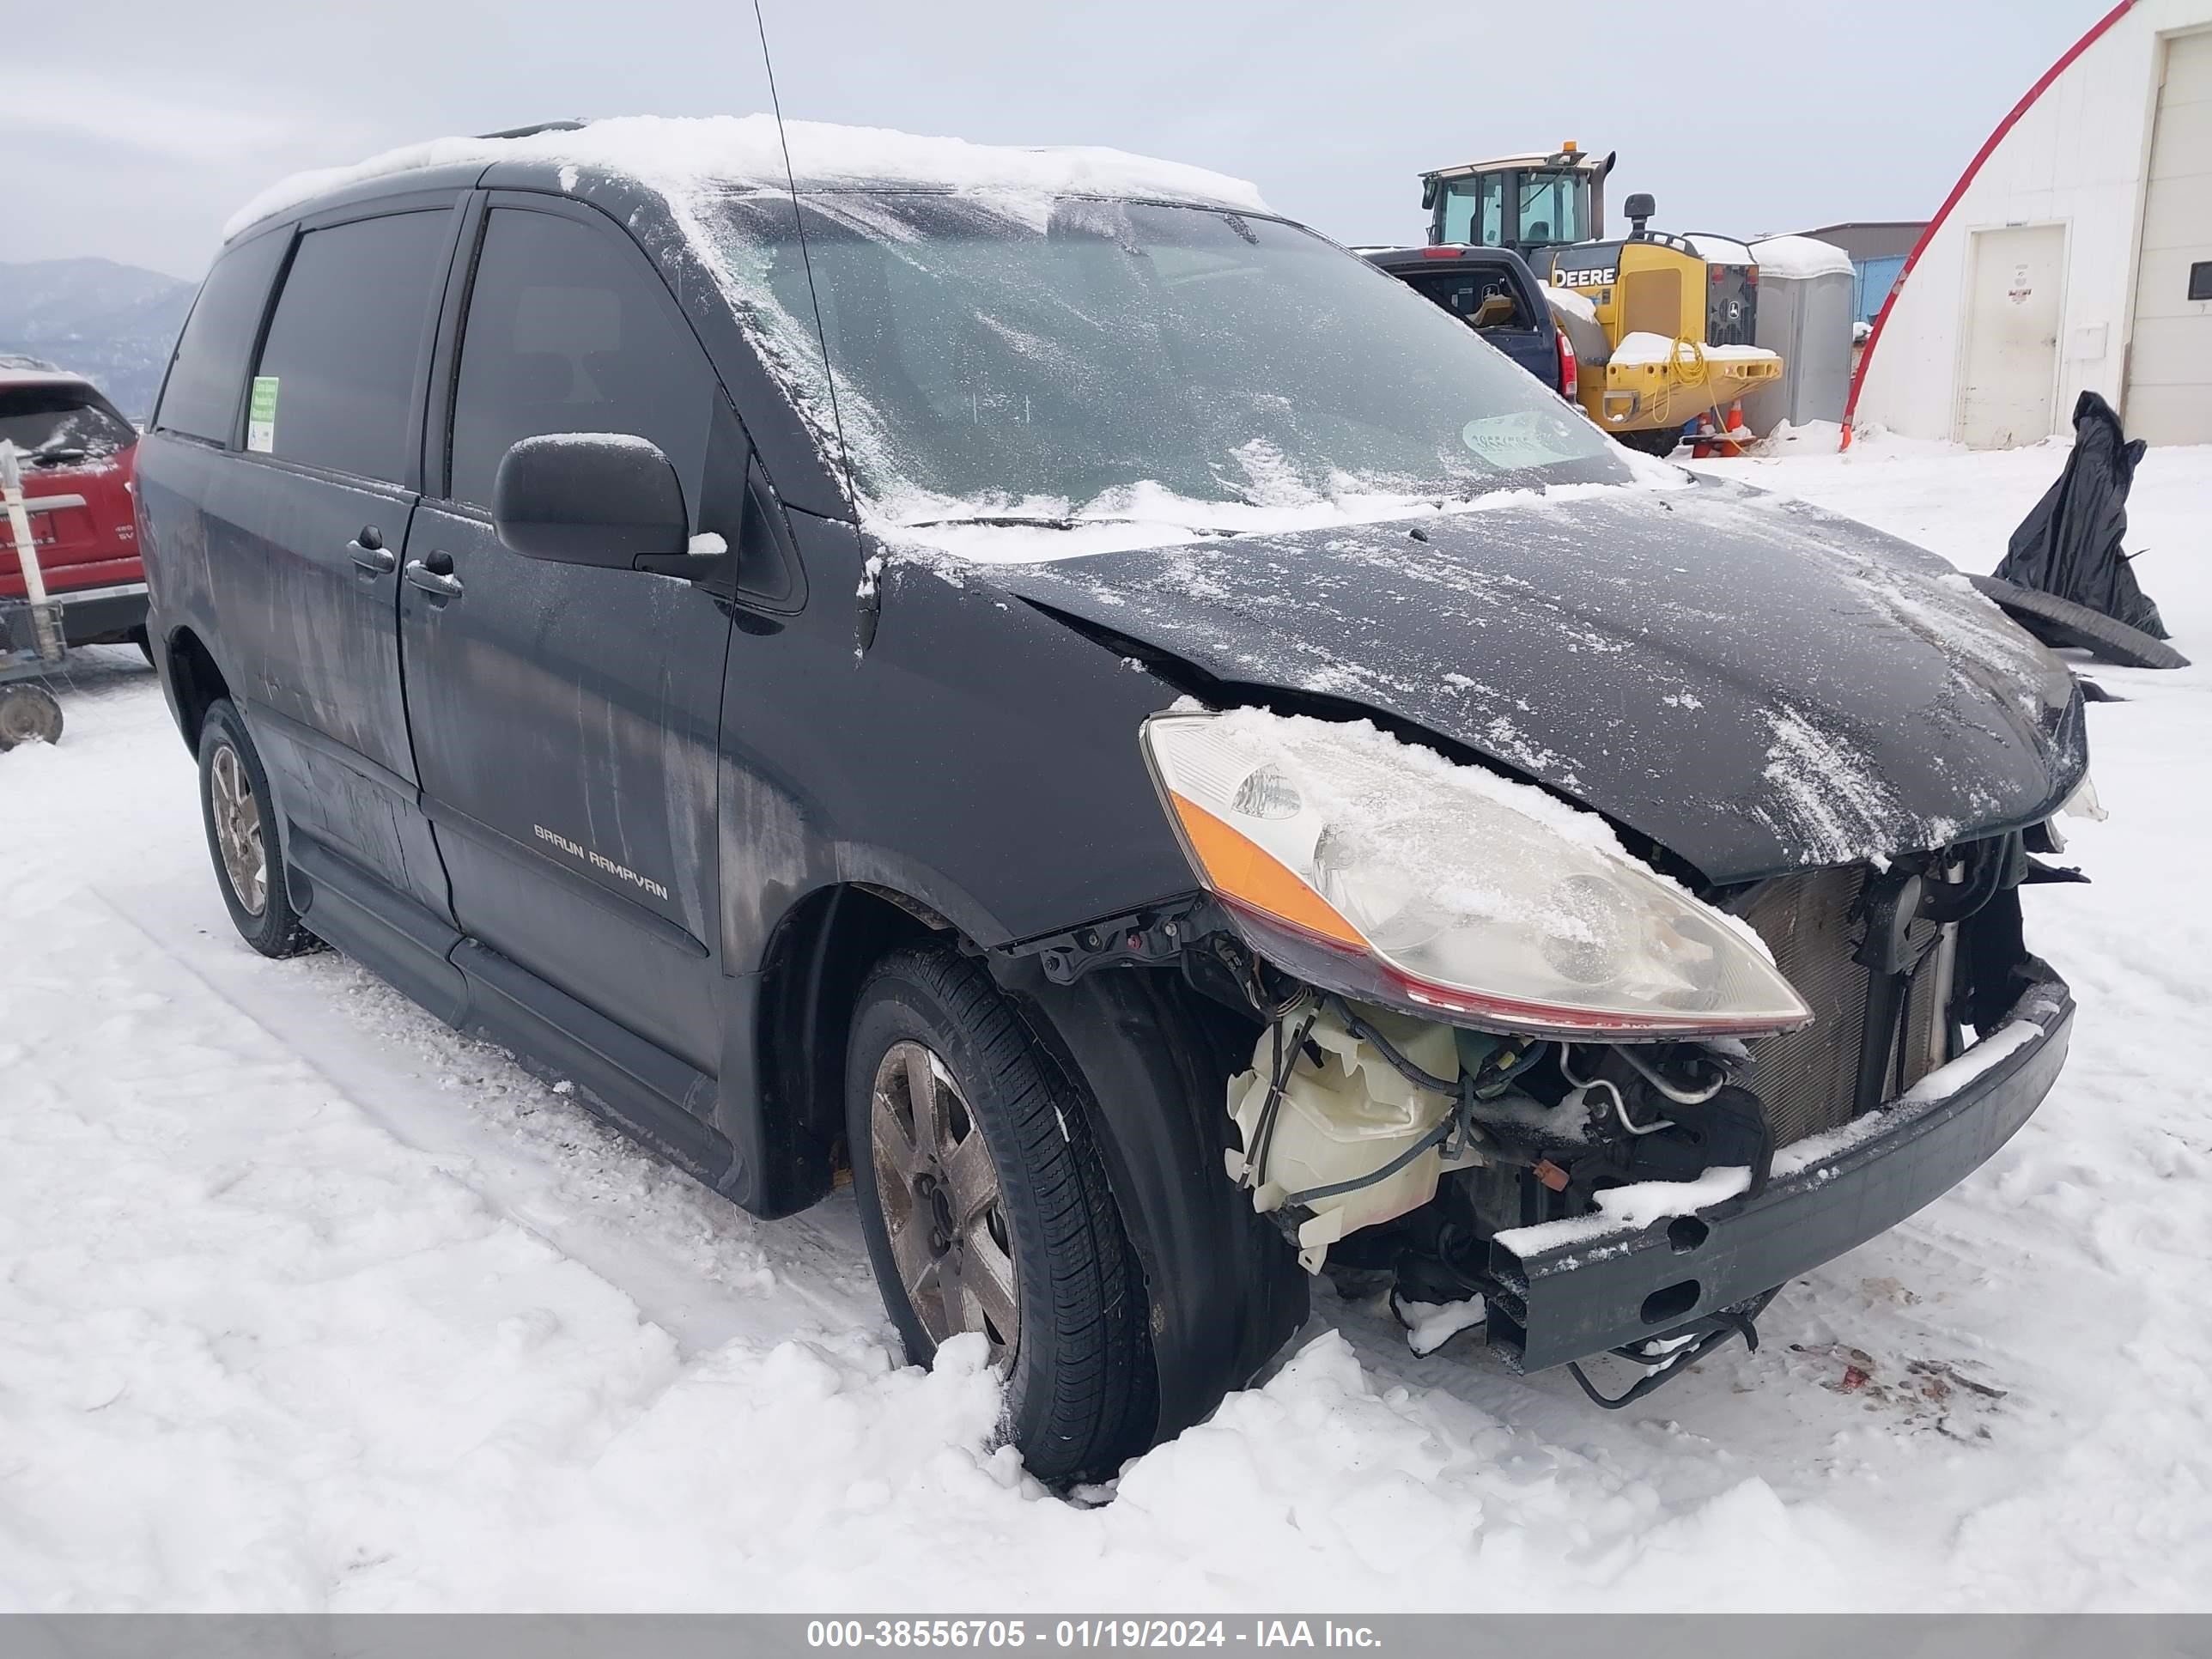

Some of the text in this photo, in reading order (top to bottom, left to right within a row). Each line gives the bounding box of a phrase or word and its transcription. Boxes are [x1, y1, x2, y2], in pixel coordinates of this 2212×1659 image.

[1554, 268, 1615, 288] DEERE
[533, 823, 669, 901] BRAUN RAMPVAN
